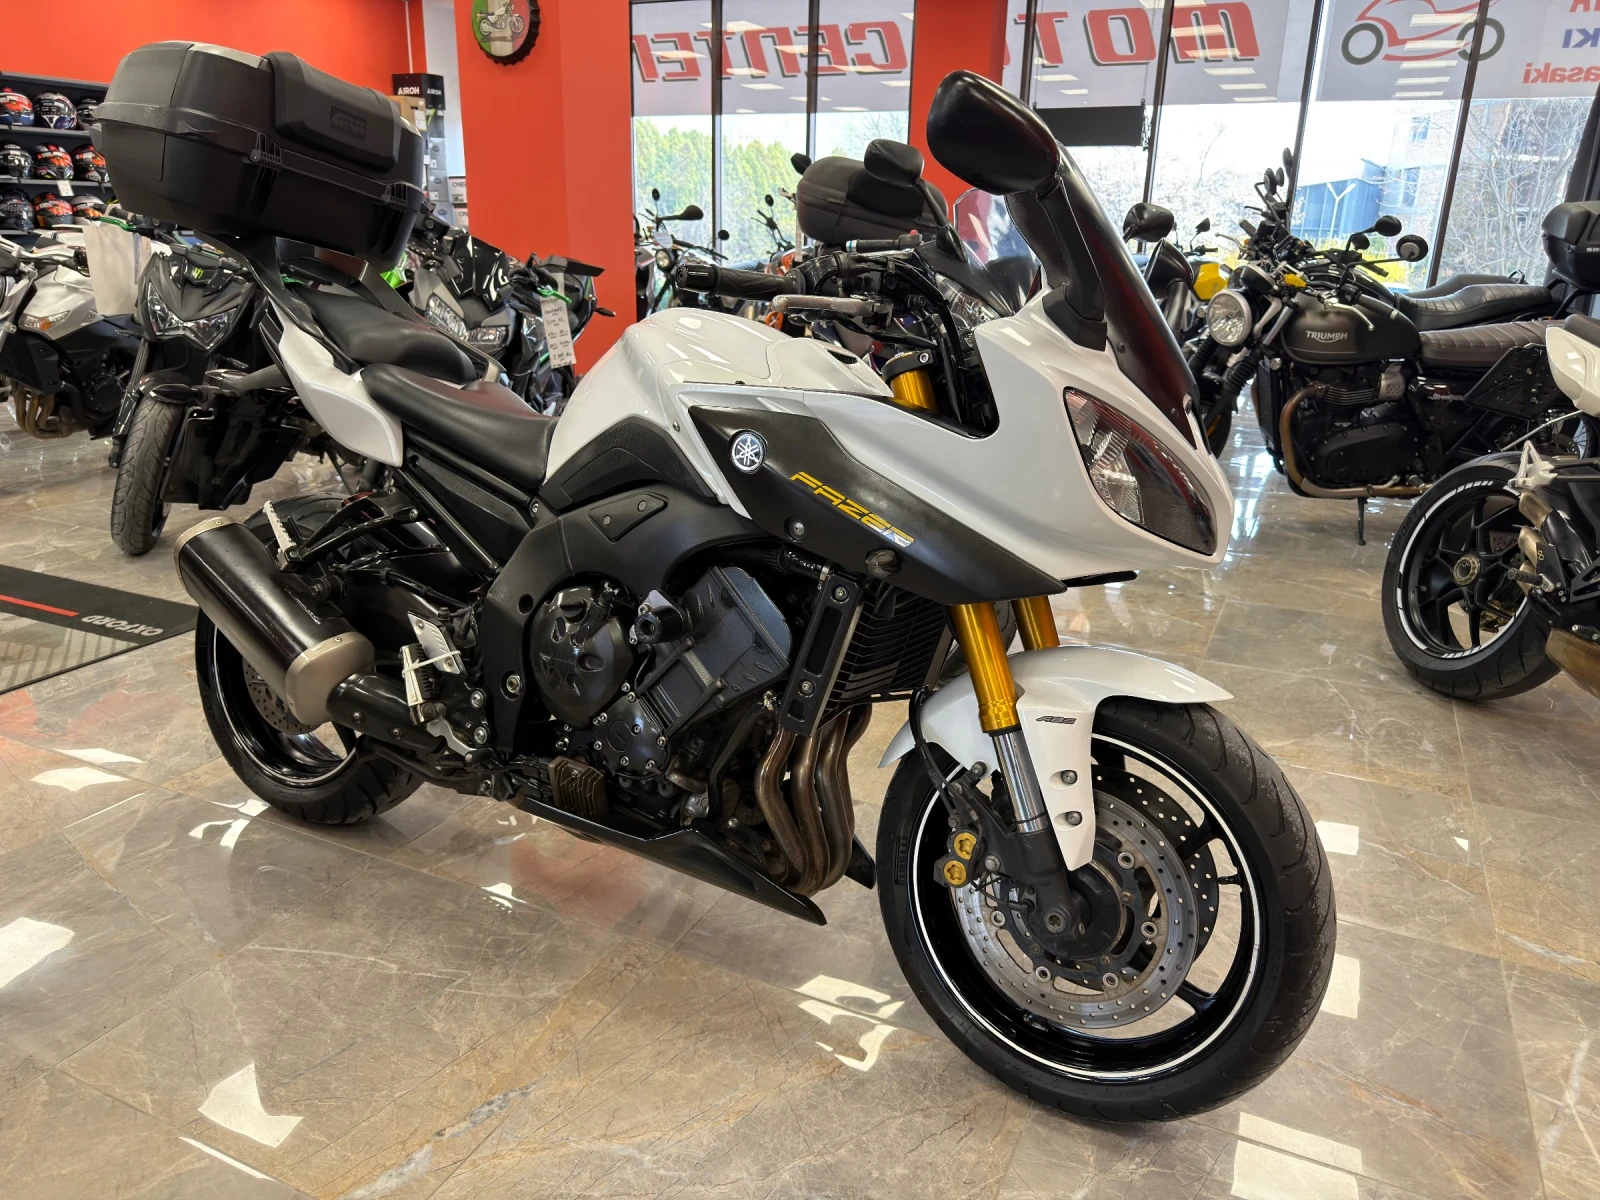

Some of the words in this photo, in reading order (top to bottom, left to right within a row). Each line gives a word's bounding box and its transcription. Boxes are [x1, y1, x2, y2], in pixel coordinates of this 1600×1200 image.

[397, 86, 420, 95] AIROH
[426, 88, 442, 96] AIROH
[1306, 330, 1348, 343] TRIUMPH
[790, 471, 915, 548] FAZER
[81, 615, 164, 636] OXFORD
[1036, 716, 1077, 724] ABS
